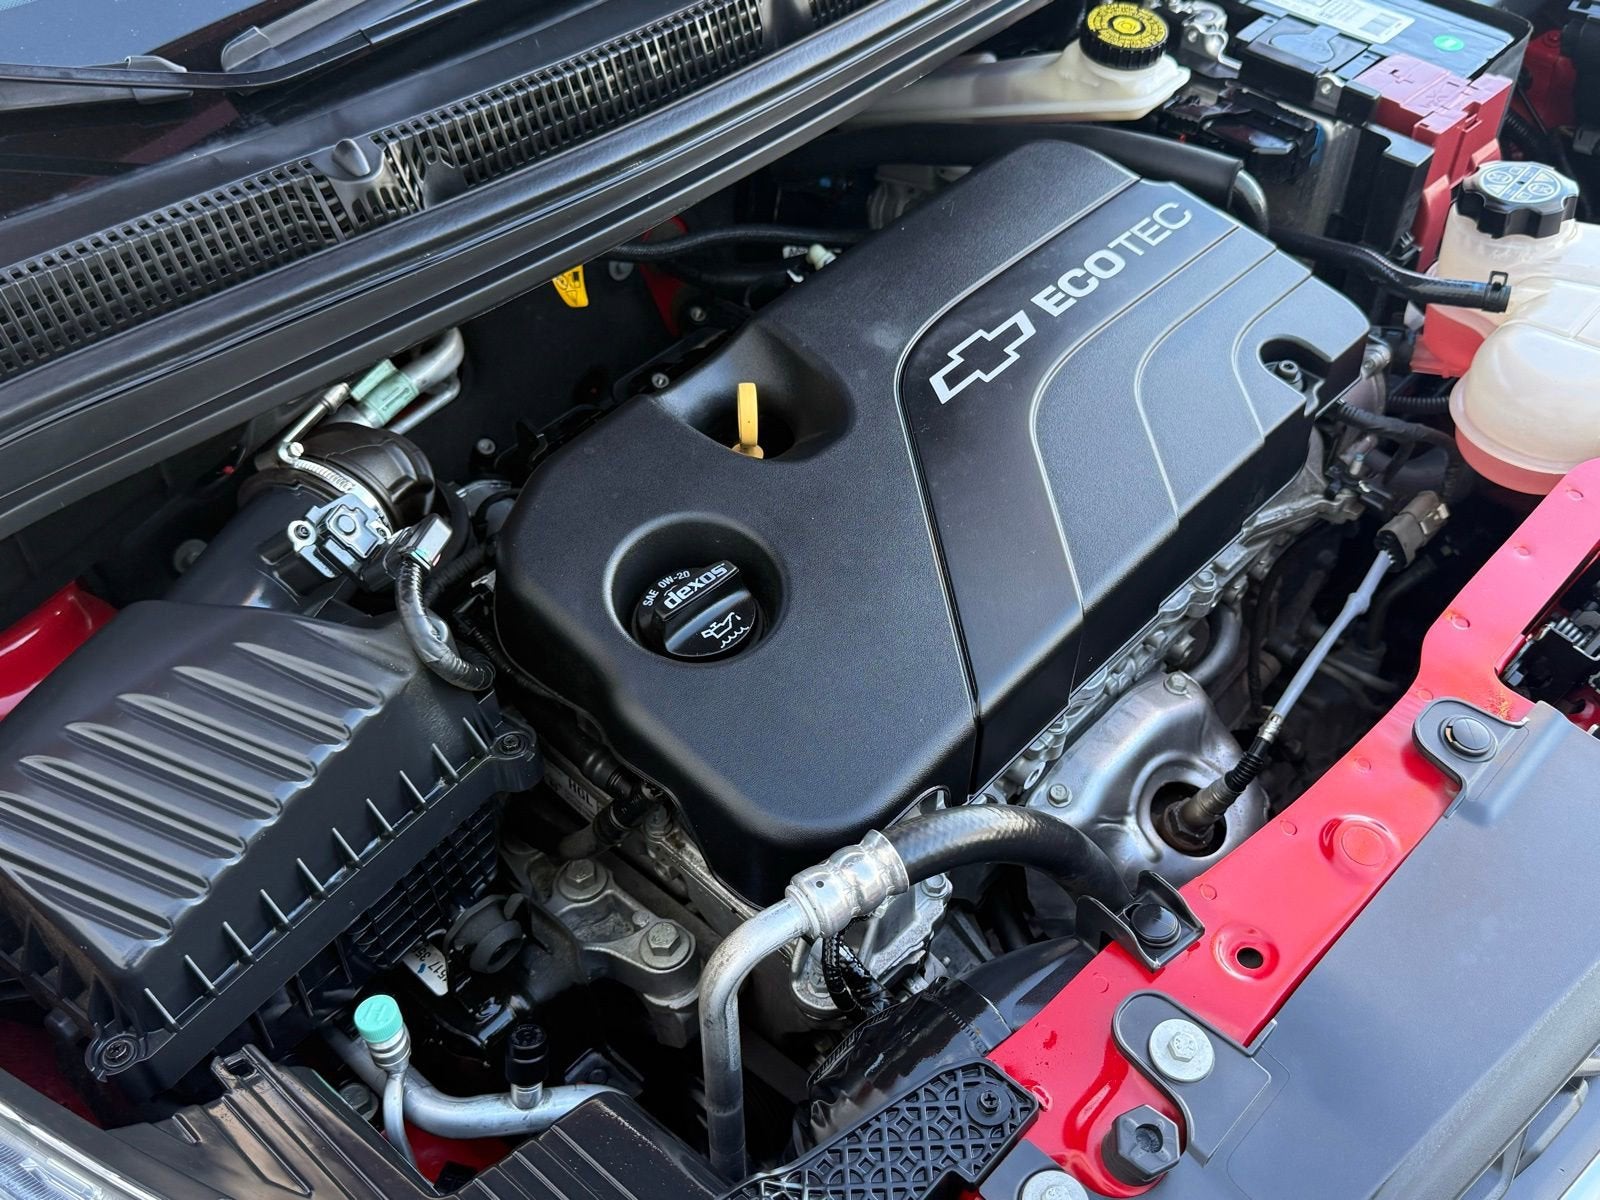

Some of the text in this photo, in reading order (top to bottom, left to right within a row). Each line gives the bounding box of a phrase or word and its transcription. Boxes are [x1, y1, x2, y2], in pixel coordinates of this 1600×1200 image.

[1030, 202, 1193, 318] ECOTEC
[642, 570, 691, 606] SAE 0W-20
[663, 564, 728, 609] dexos
